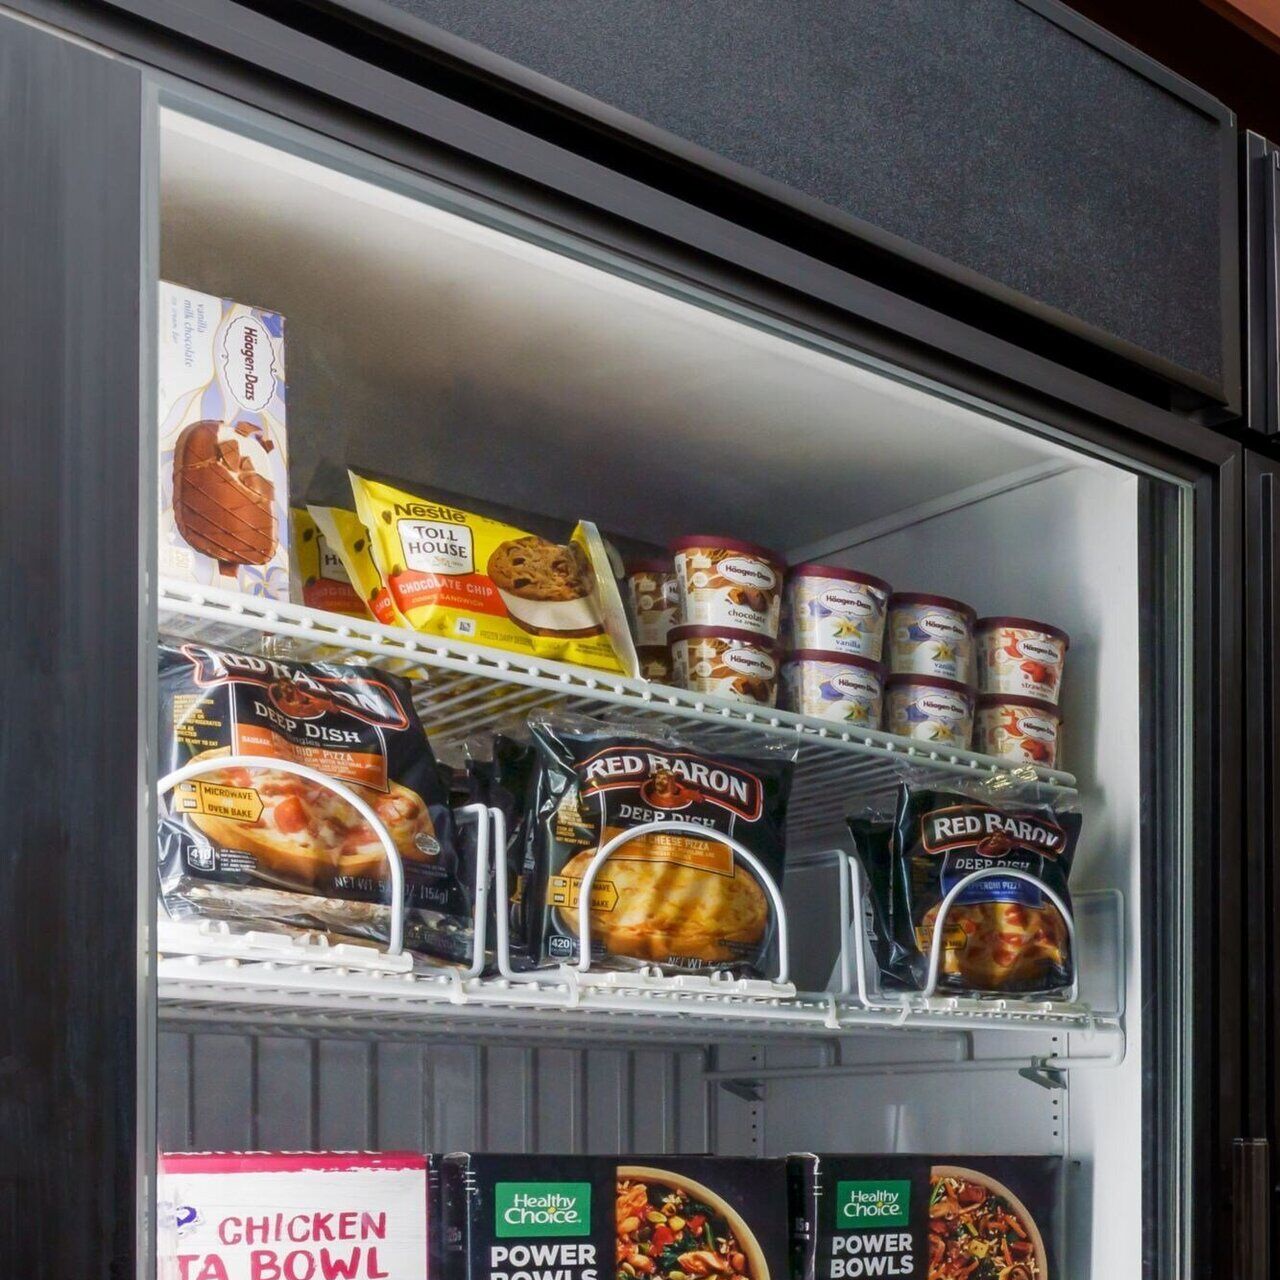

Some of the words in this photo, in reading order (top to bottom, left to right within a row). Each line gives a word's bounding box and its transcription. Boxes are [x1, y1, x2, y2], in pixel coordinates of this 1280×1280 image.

[413, 526, 458, 541] TOLL
[409, 542, 468, 558] HOUSE
[398, 577, 461, 594] CHOCOLATE
[467, 584, 493, 596] CHIP
[254, 701, 298, 732] DEEP
[305, 721, 362, 743] DISH
[584, 755, 644, 782] RED
[647, 753, 750, 806] BARON
[204, 786, 253, 800] MICROWAVE
[619, 804, 666, 822] DEEP
[933, 816, 981, 840] RED
[513, 1193, 577, 1209] Healthy
[850, 1190, 899, 1204] Healthy
[504, 1206, 578, 1225] Choice
[843, 1202, 900, 1217] Choice
[217, 1212, 387, 1246] CHICKEN
[832, 1233, 913, 1255] POWER
[491, 1244, 596, 1268] POWER
[830, 1255, 914, 1279] BOWLS
